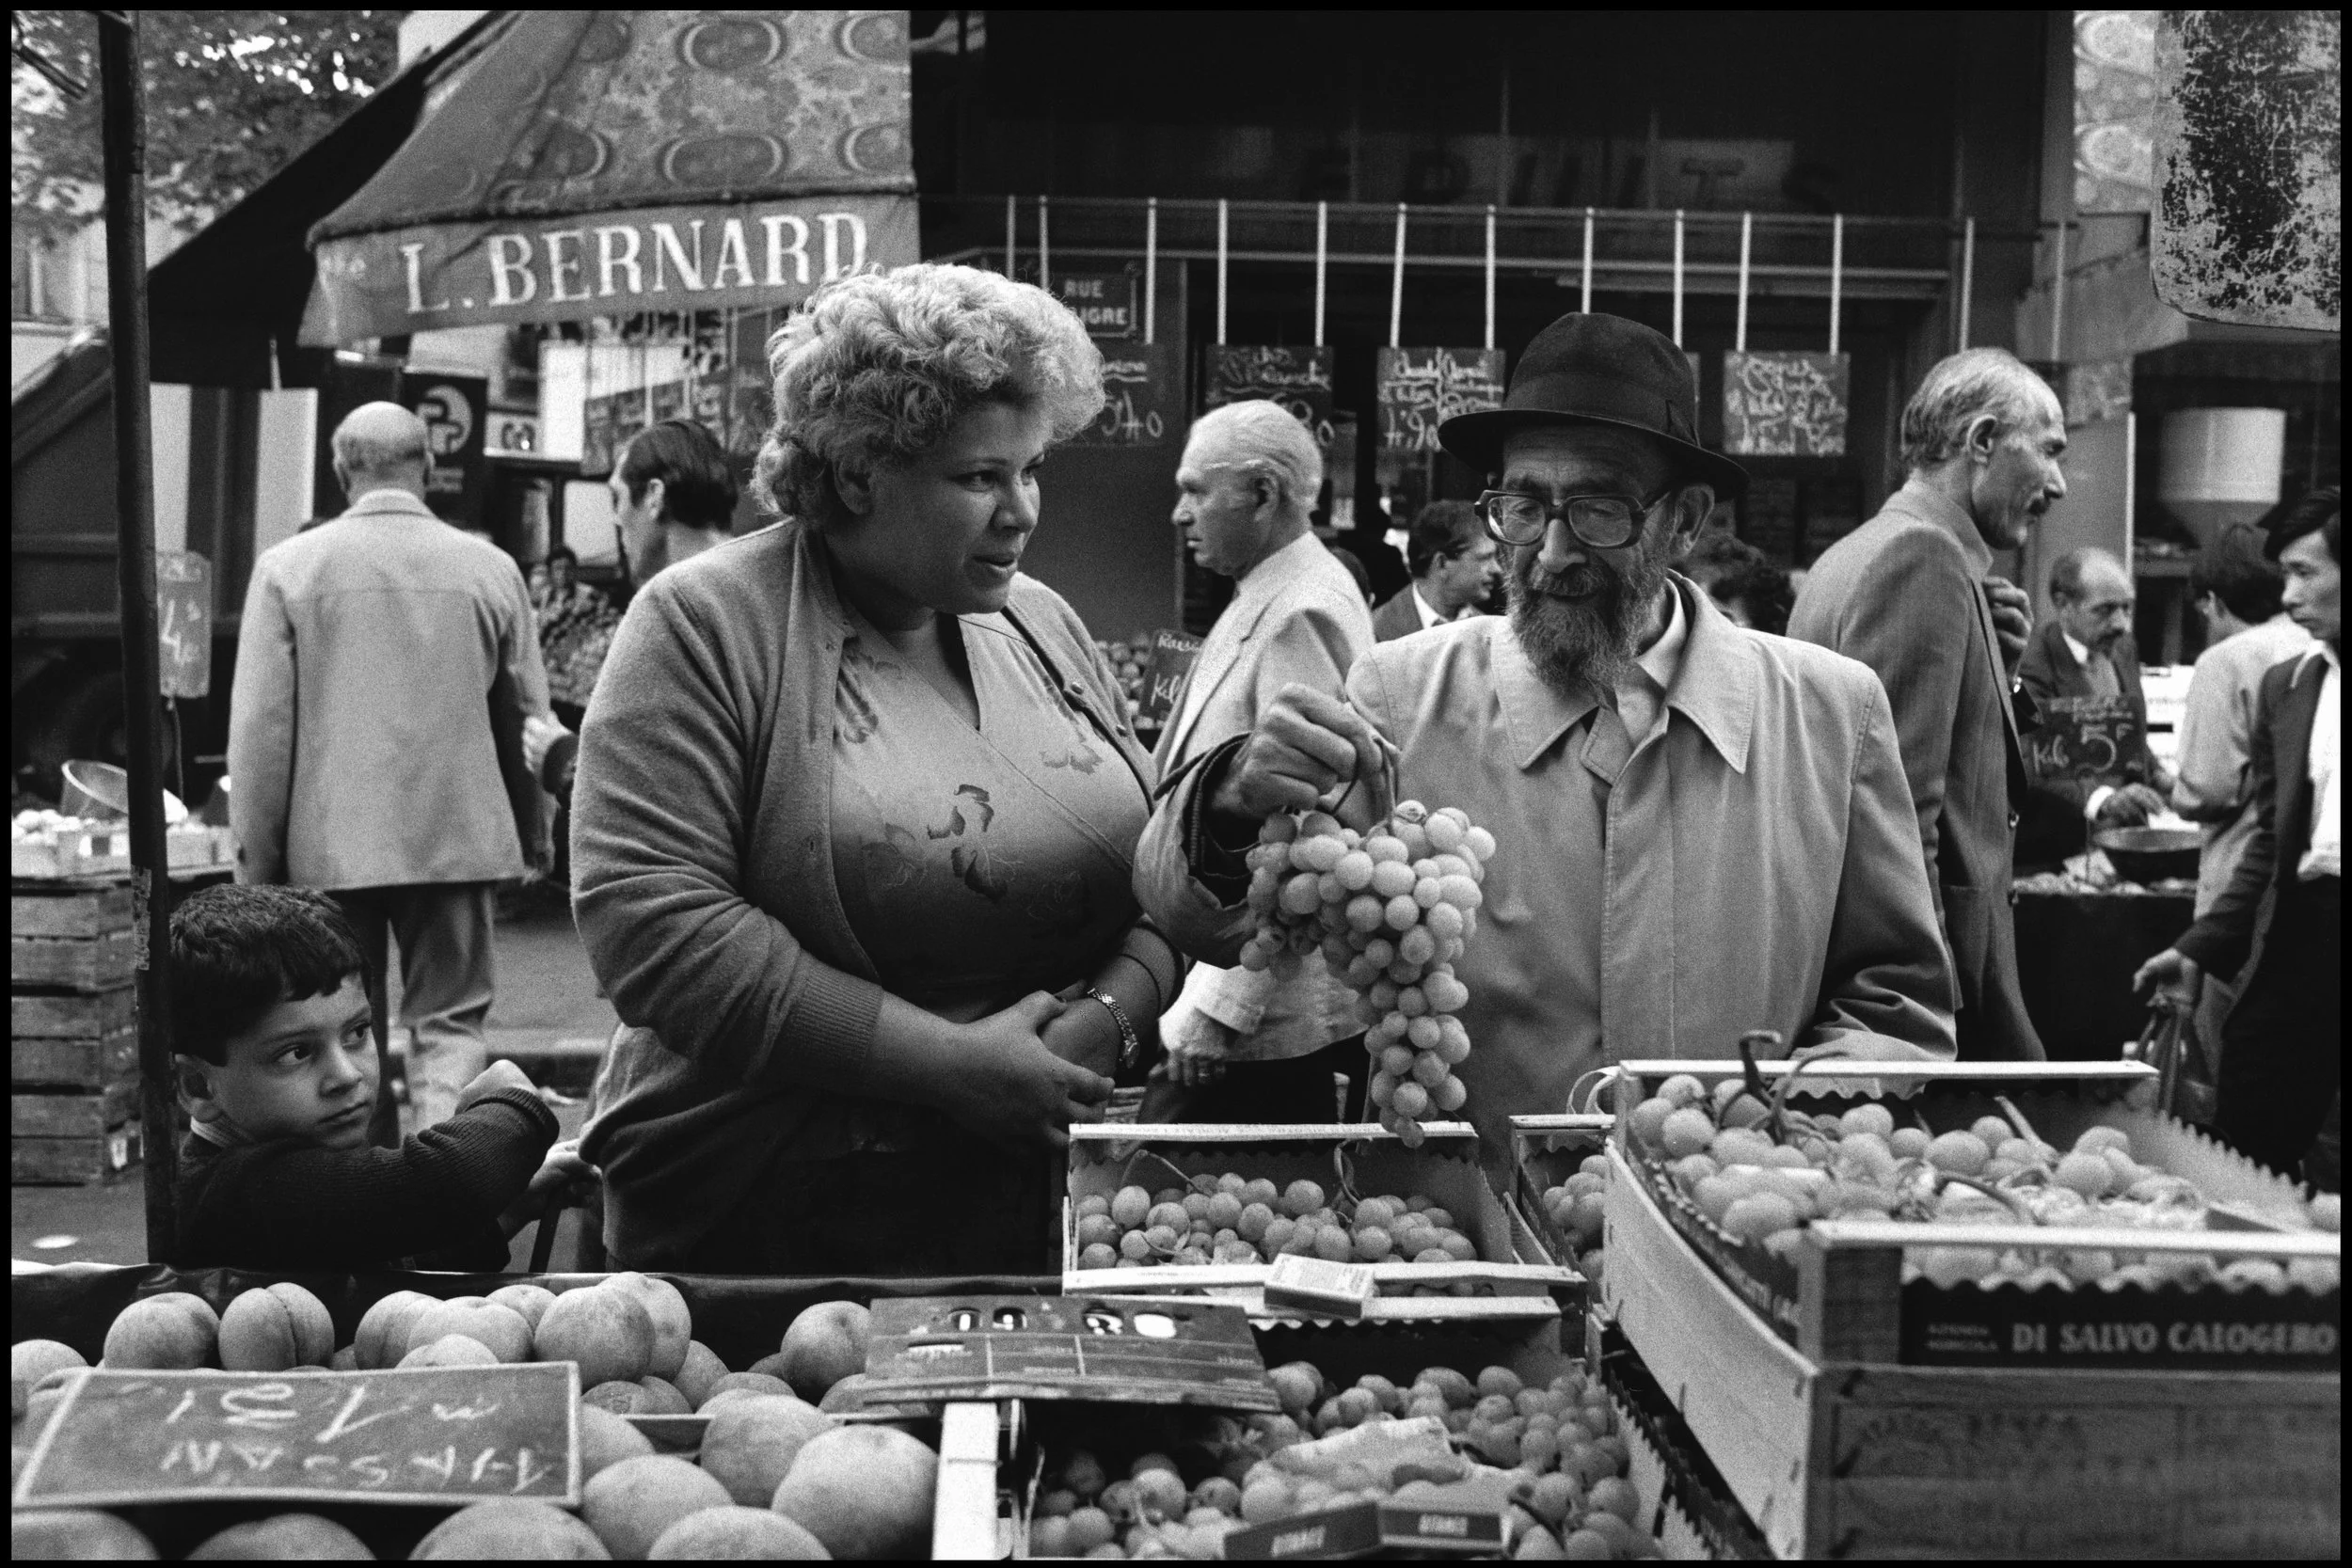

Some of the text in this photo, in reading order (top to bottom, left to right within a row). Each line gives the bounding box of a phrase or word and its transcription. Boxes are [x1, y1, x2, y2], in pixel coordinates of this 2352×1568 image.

[398, 213, 868, 313] L. BERNARD
[1064, 280, 1104, 298] RUE
[1081, 308, 1128, 325] IGRE
[1151, 673, 1181, 707] Kil
[2011, 1323, 2047, 1353] DI
[2059, 1323, 2159, 1353] SALVO
